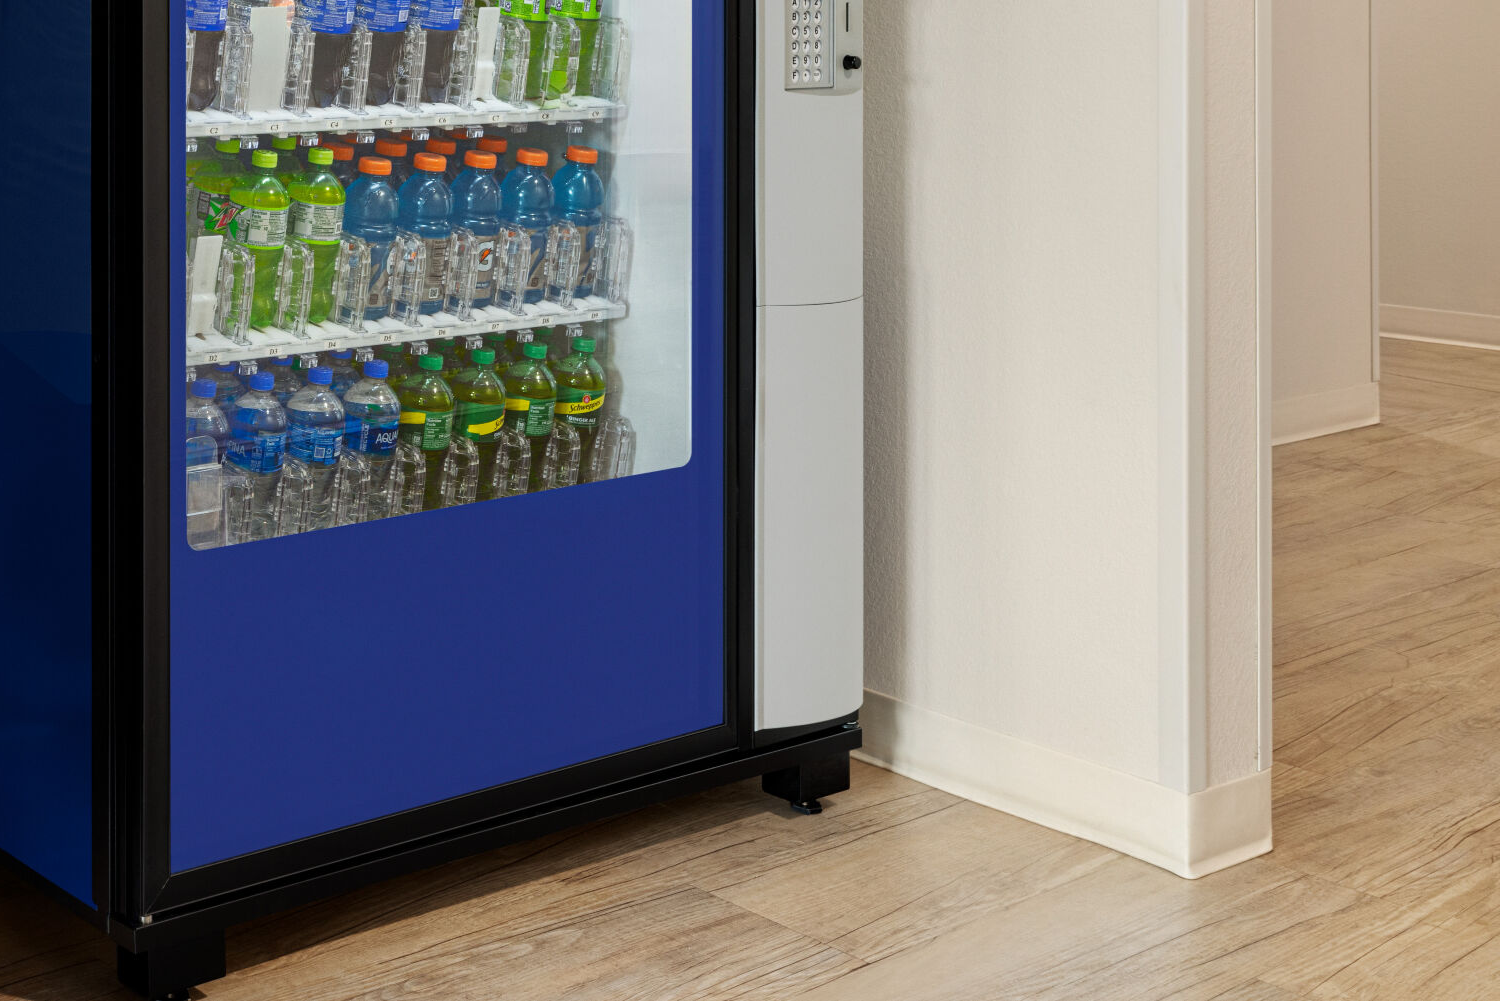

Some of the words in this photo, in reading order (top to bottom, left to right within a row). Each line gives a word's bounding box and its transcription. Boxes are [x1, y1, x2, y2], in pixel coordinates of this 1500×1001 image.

[792, 12, 797, 20] B
[803, 12, 807, 20] 3
[803, 27, 808, 35] 5
[814, 27, 818, 35] 6
[792, 42, 797, 50] D
[792, 57, 797, 65] E
[803, 56, 808, 64] 9
[814, 56, 818, 64] 0
[569, 401, 600, 413] Schweppes
